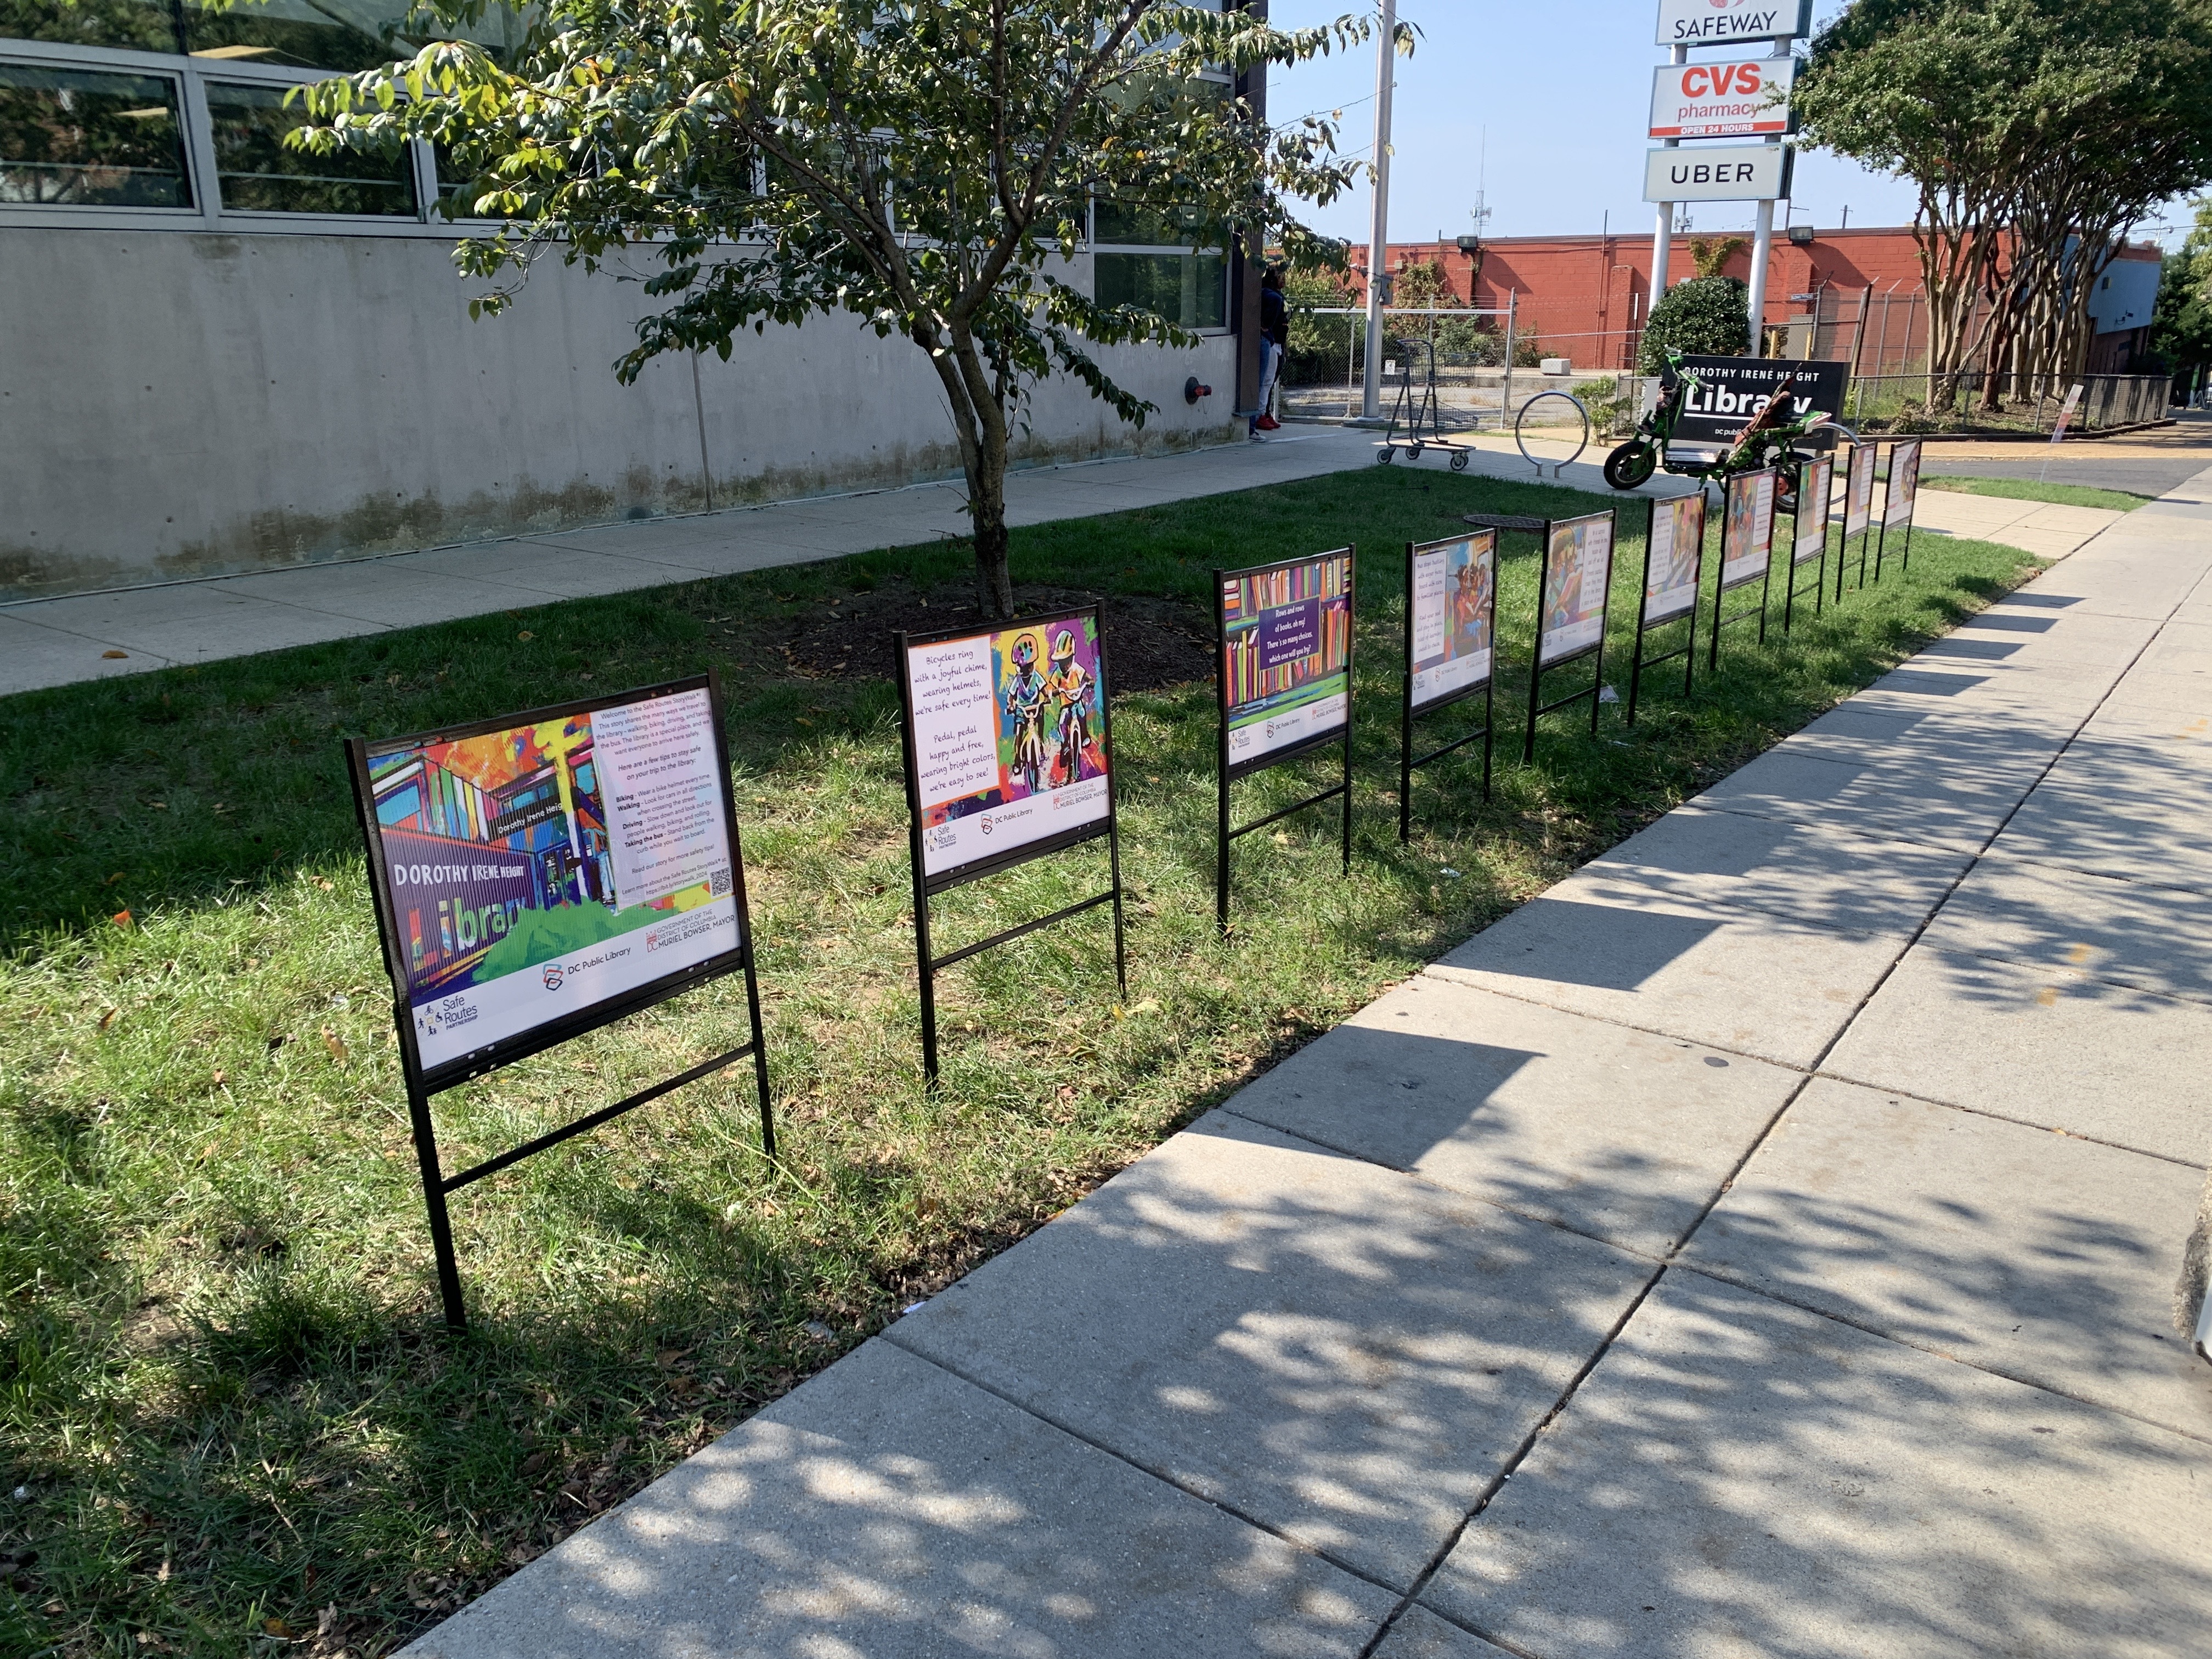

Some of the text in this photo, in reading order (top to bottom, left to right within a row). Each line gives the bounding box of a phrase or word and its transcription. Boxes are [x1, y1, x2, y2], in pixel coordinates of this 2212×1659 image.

[1674, 10, 1778, 39] SAFEWAY
[1681, 63, 1761, 99] CVS
[1677, 103, 1761, 122] pharmacy
[1681, 123, 1754, 135] OPEN 24 HOURS
[1671, 163, 1754, 184] UBER
[1776, 371, 1820, 382] HEGHT
[1685, 384, 1813, 414] Libray
[1275, 605, 1305, 618] Rows and rows
[1274, 623, 1279, 633] of
[1293, 619, 1298, 628] oh
[1287, 635, 1298, 645] many
[926, 650, 973, 668] Bicycles ring
[1268, 653, 1280, 664] which
[914, 673, 929, 683] with
[938, 665, 962, 682] joyful
[964, 663, 987, 673] chime,
[922, 679, 981, 698] wearing helmets,
[600, 710, 626, 719] Welcome
[642, 702, 654, 710] Safe
[654, 699, 672, 708] Routes
[686, 702, 699, 710] travel
[915, 690, 991, 716] we're safe every time!
[659, 725, 676, 736] special
[933, 725, 977, 743] Pedal, pedal
[1238, 729, 1246, 738] Safe
[628, 743, 652, 752] everyone
[659, 754, 670, 762] tips
[690, 745, 701, 754] safe
[929, 739, 984, 763] happy and free,
[635, 770, 649, 780] your
[649, 766, 659, 775] trip
[677, 758, 696, 767] library:
[921, 753, 995, 779] wearing bright colors,
[929, 767, 988, 792] we're easy to see!
[616, 794, 634, 803] Biking
[1059, 786, 1082, 797] GOVERNMENT
[1059, 793, 1074, 802] DISTRICT
[1060, 799, 1075, 808] MURIEL
[1093, 788, 1107, 798] MAYOR
[617, 802, 640, 812] Walking
[995, 808, 1033, 824] DC Public Library
[497, 801, 563, 834] Dorothy Irene Heig
[938, 825, 950, 836] Safe
[938, 833, 956, 845] Routes
[631, 865, 645, 874] Read
[689, 848, 704, 856] safety
[704, 843, 715, 852] tips!
[394, 864, 524, 887] DOROTHY IRENE HEIGHT
[657, 915, 693, 934] GOVERNMENT
[703, 909, 713, 917] THE
[657, 927, 680, 940] DISTRICT
[689, 915, 716, 929] COLUMBIA
[658, 914, 735, 949] MURIEL BOWSER, MAYOR
[646, 939, 658, 953] DC
[568, 947, 631, 975] DC Public Library
[443, 995, 465, 1012] Safe
[444, 1005, 478, 1024] Routes
[446, 1014, 478, 1030] PARTNERSHIP
